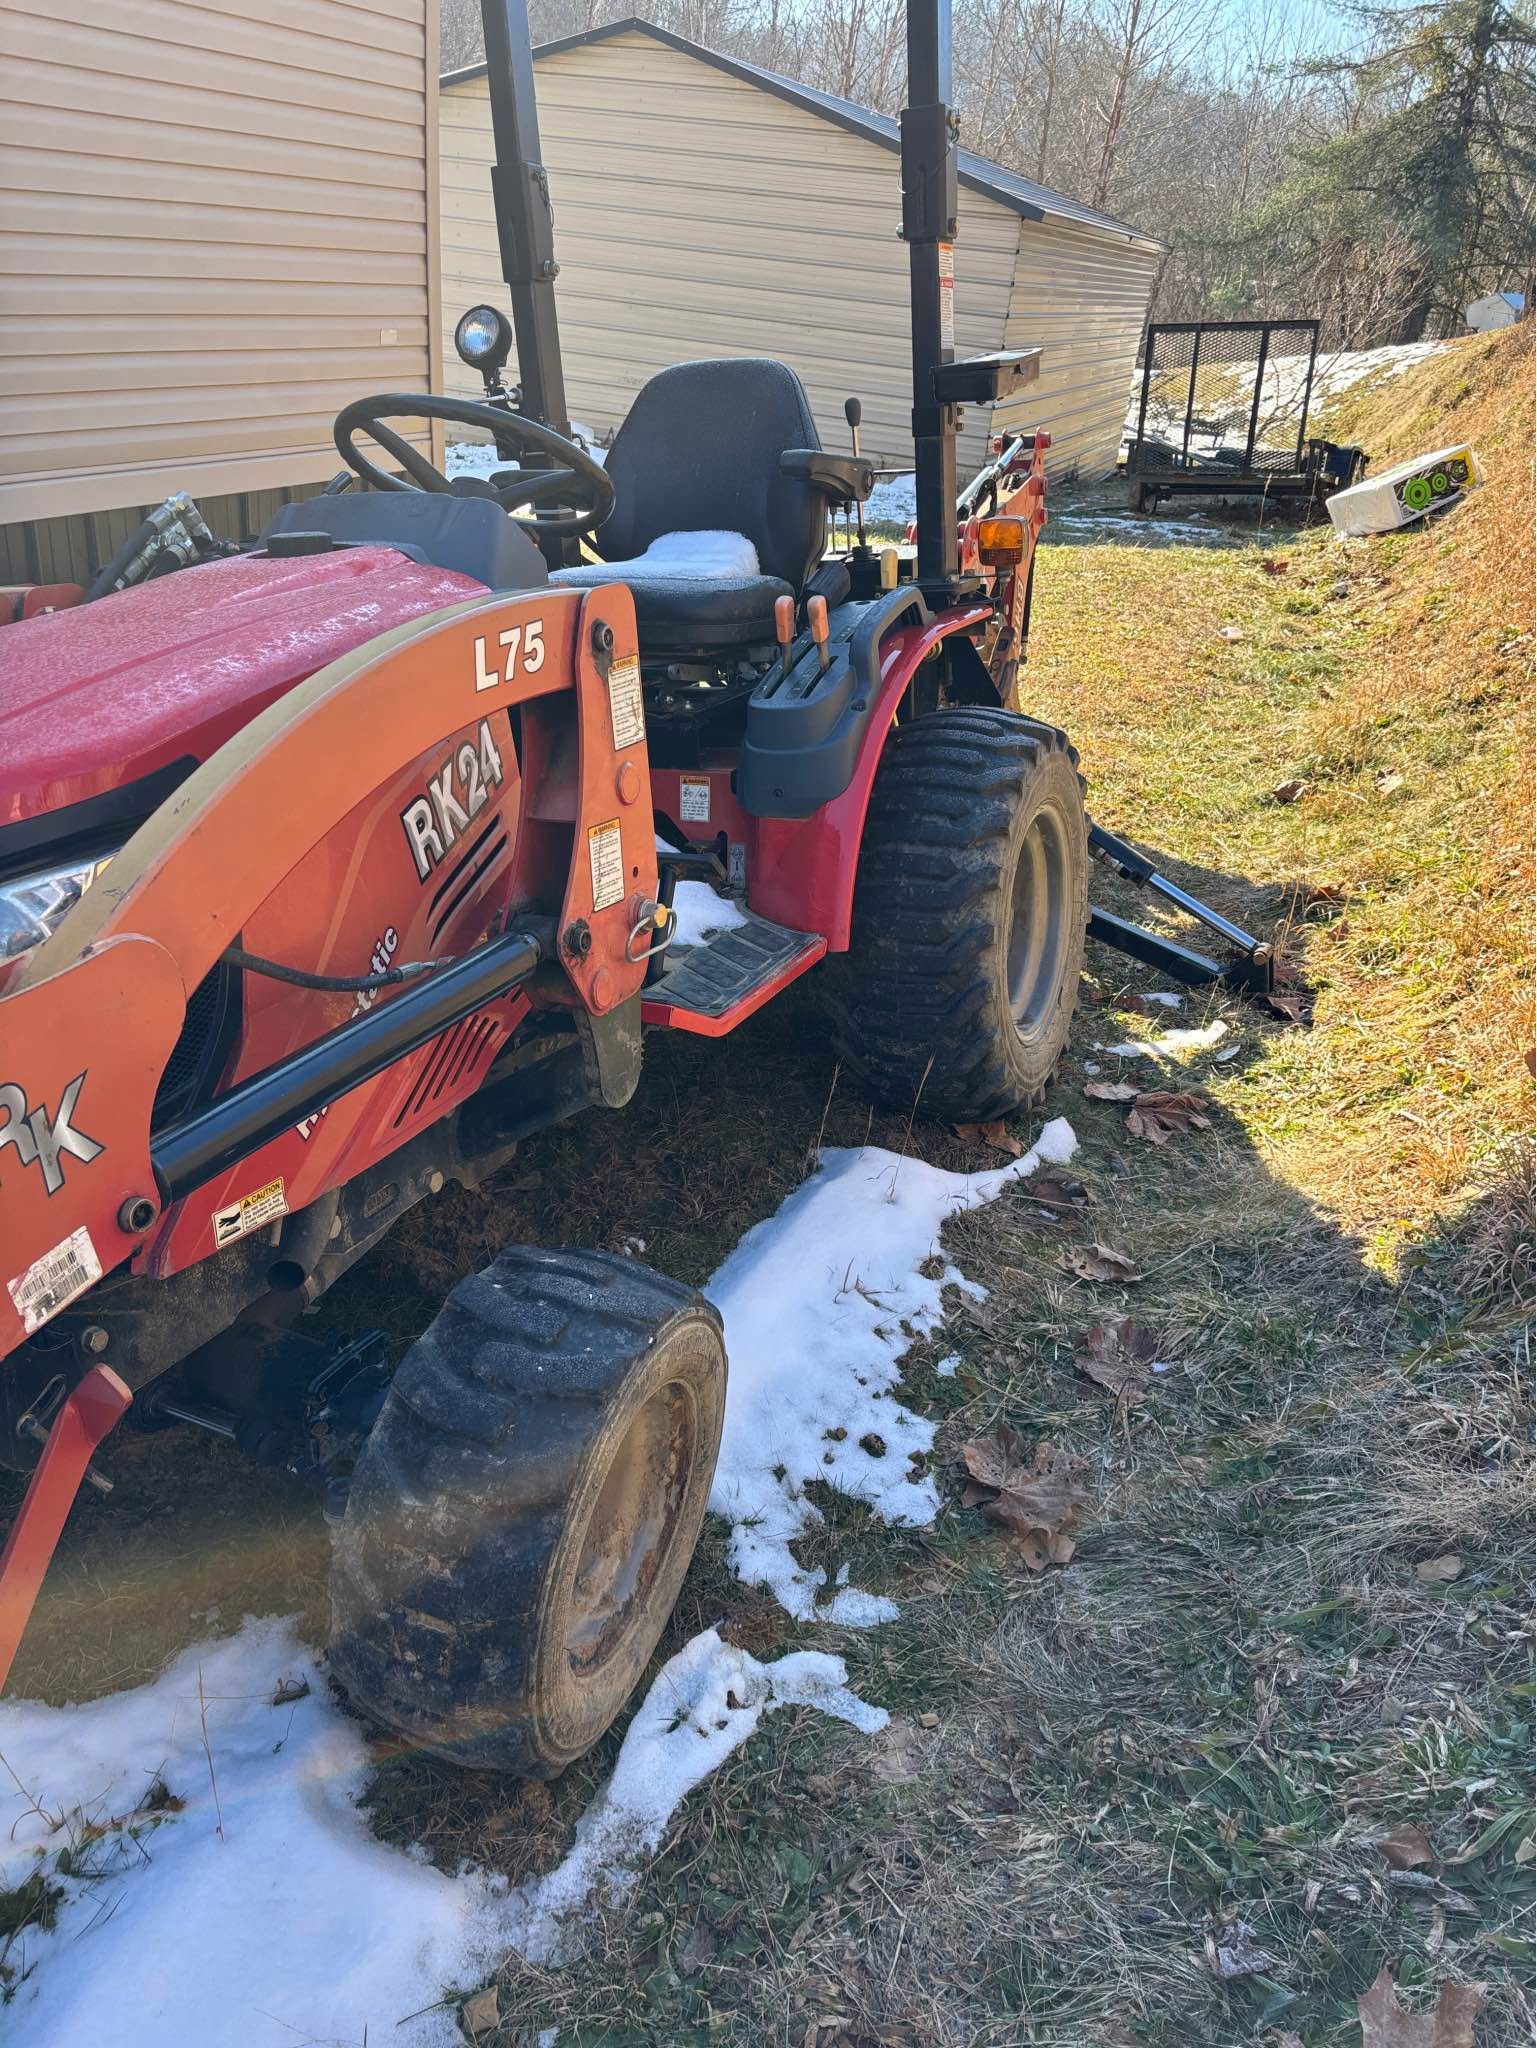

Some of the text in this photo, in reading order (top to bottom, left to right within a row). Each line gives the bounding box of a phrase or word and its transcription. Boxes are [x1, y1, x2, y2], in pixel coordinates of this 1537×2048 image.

[473, 618, 546, 693] L75
[400, 718, 505, 886] RK24
[251, 1181, 281, 1204] CAUTION
